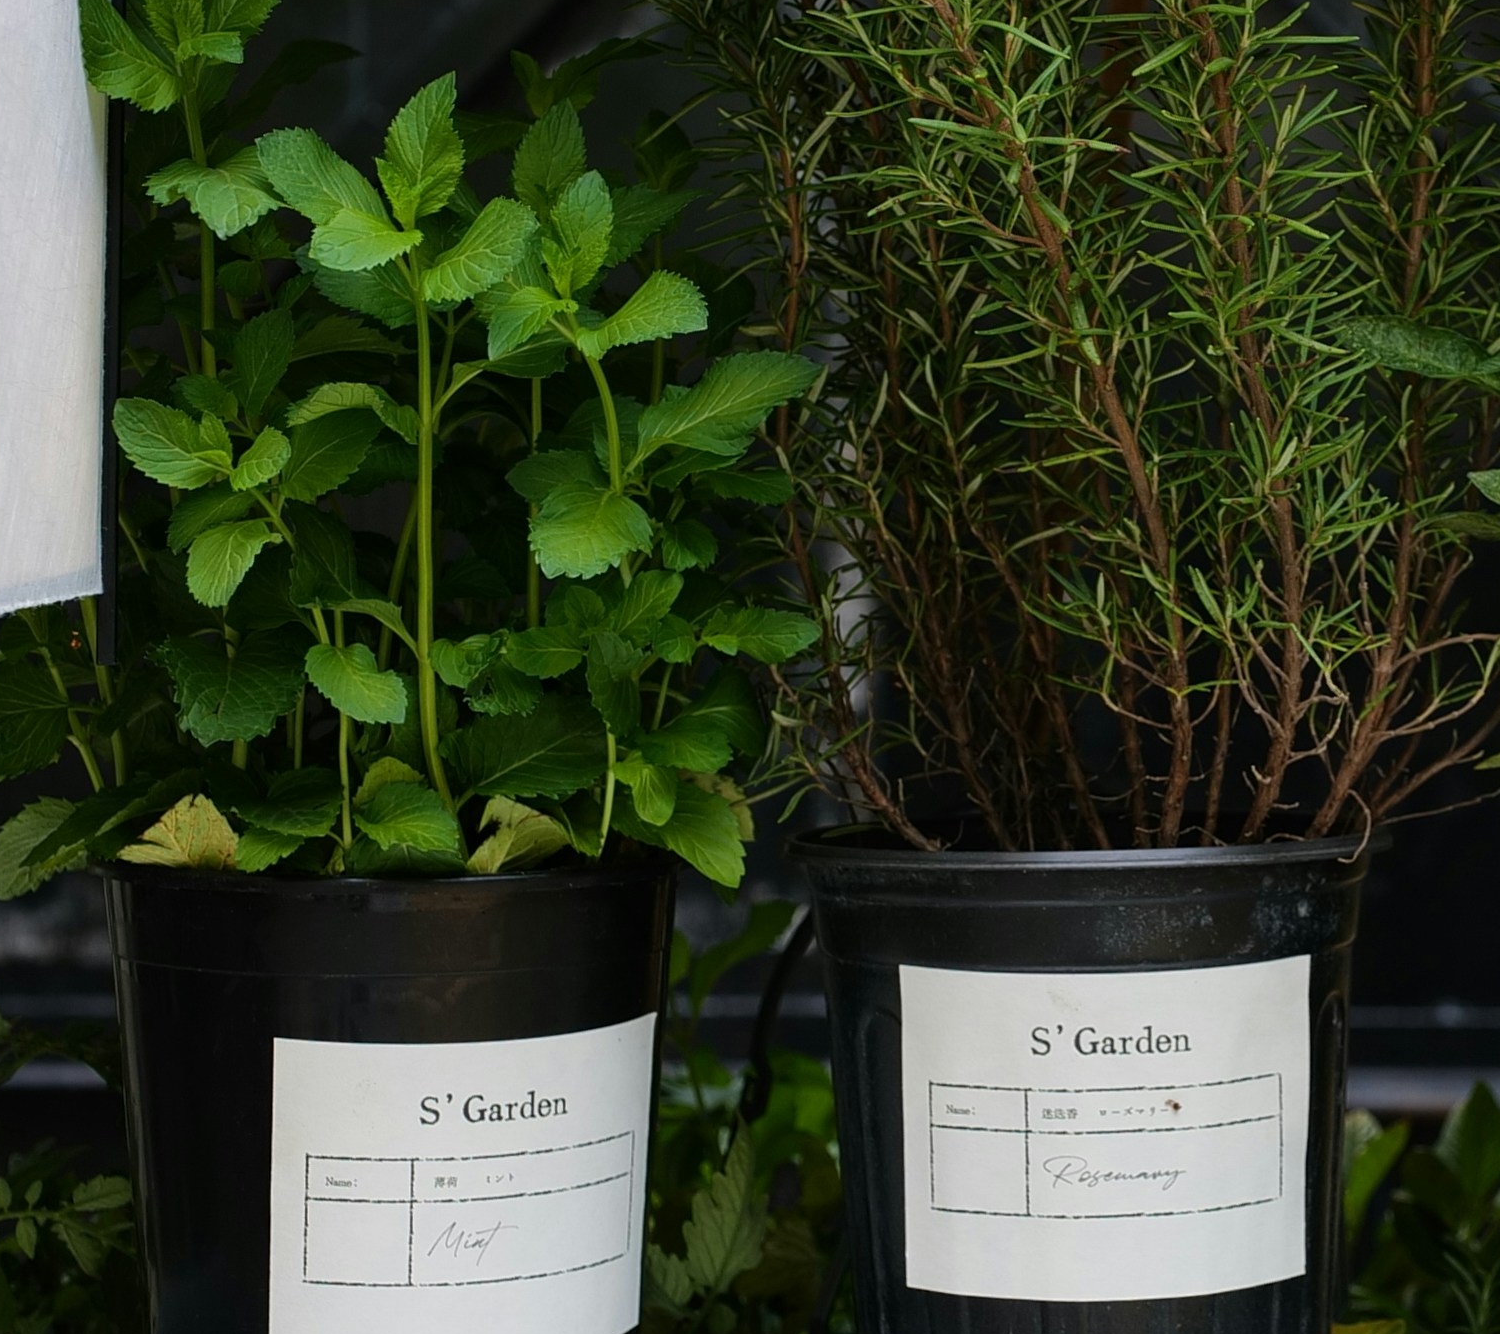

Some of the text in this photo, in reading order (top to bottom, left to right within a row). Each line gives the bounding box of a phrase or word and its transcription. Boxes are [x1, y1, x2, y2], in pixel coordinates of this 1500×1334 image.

[1030, 1024, 1192, 1057] S' Garden
[419, 1090, 569, 1126] S' Garden
[945, 1103, 976, 1116] Name:
[324, 1175, 358, 1188] Name:
[1042, 1155, 1187, 1191] Rosemary
[426, 1220, 520, 1267] Mint
